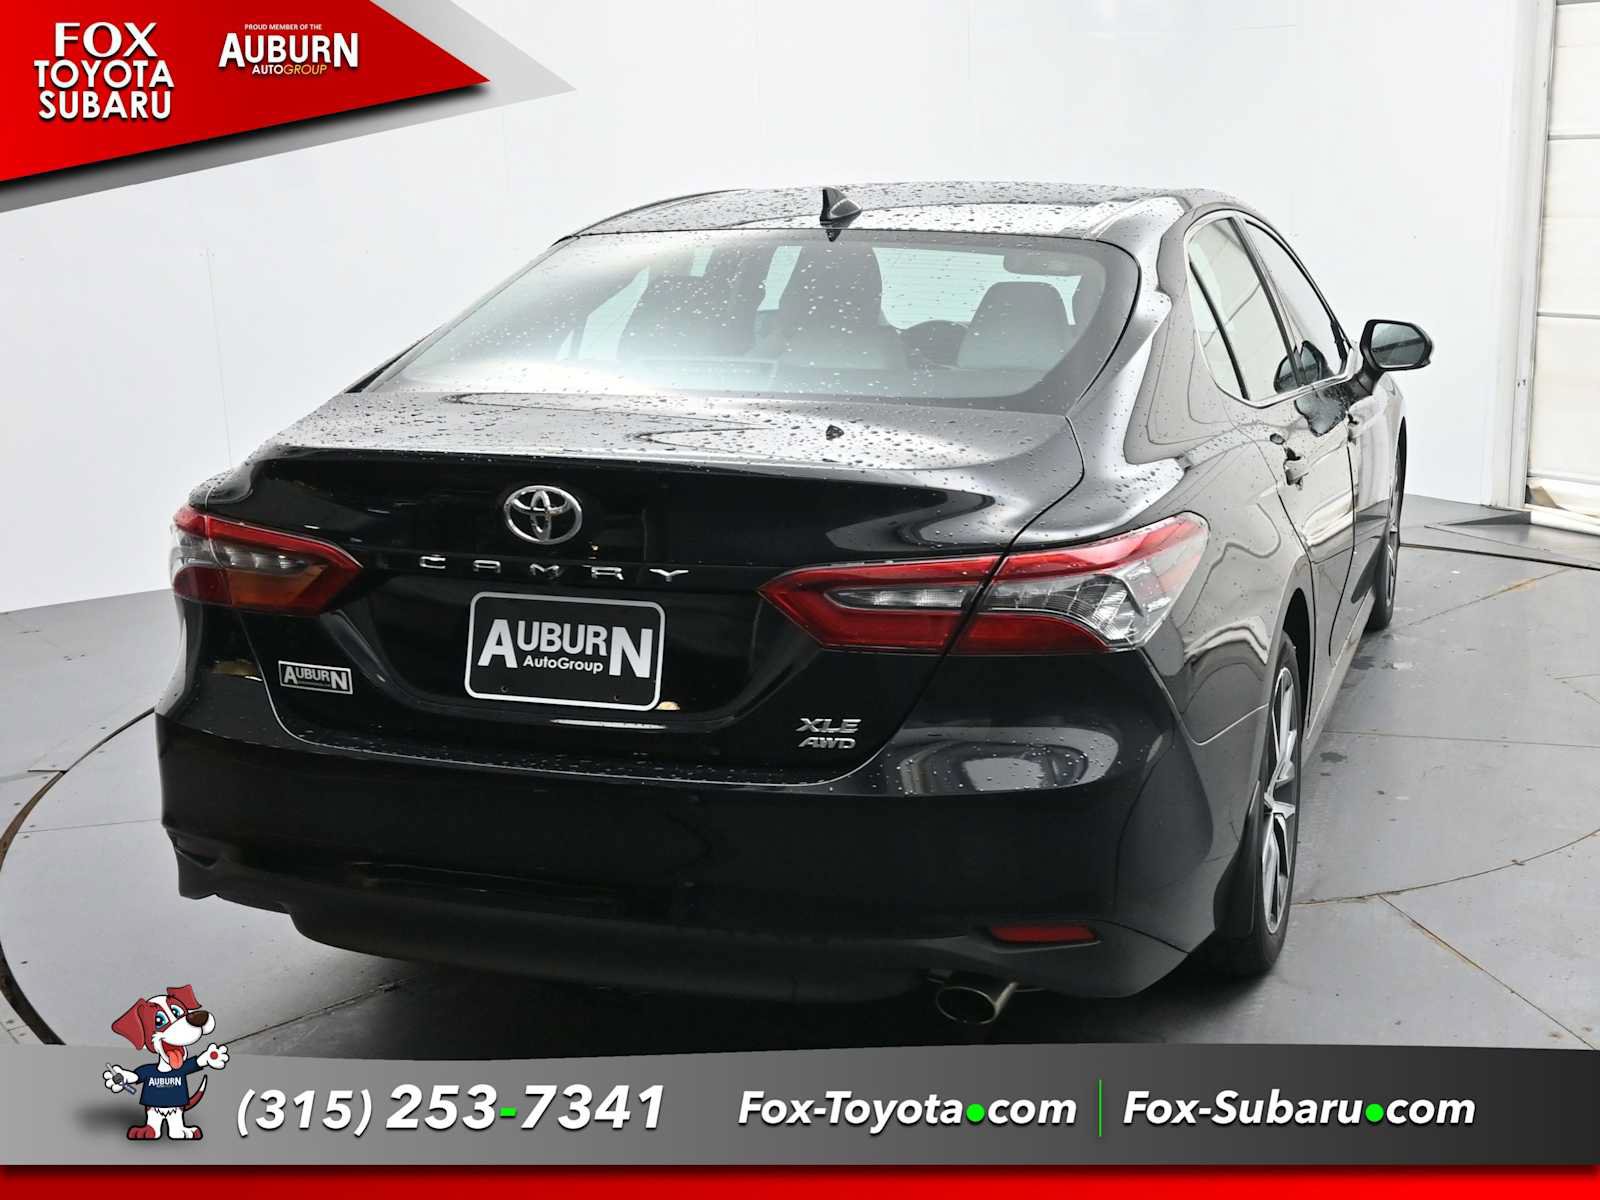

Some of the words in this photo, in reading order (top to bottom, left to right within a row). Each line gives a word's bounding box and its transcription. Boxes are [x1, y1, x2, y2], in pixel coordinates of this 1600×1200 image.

[418, 554, 690, 582] CAMRY
[477, 618, 654, 679] AUBURN
[522, 655, 604, 675] AutoGroup
[283, 665, 348, 691] AUBURN
[795, 717, 862, 733] XLE
[798, 736, 857, 749] AWD
